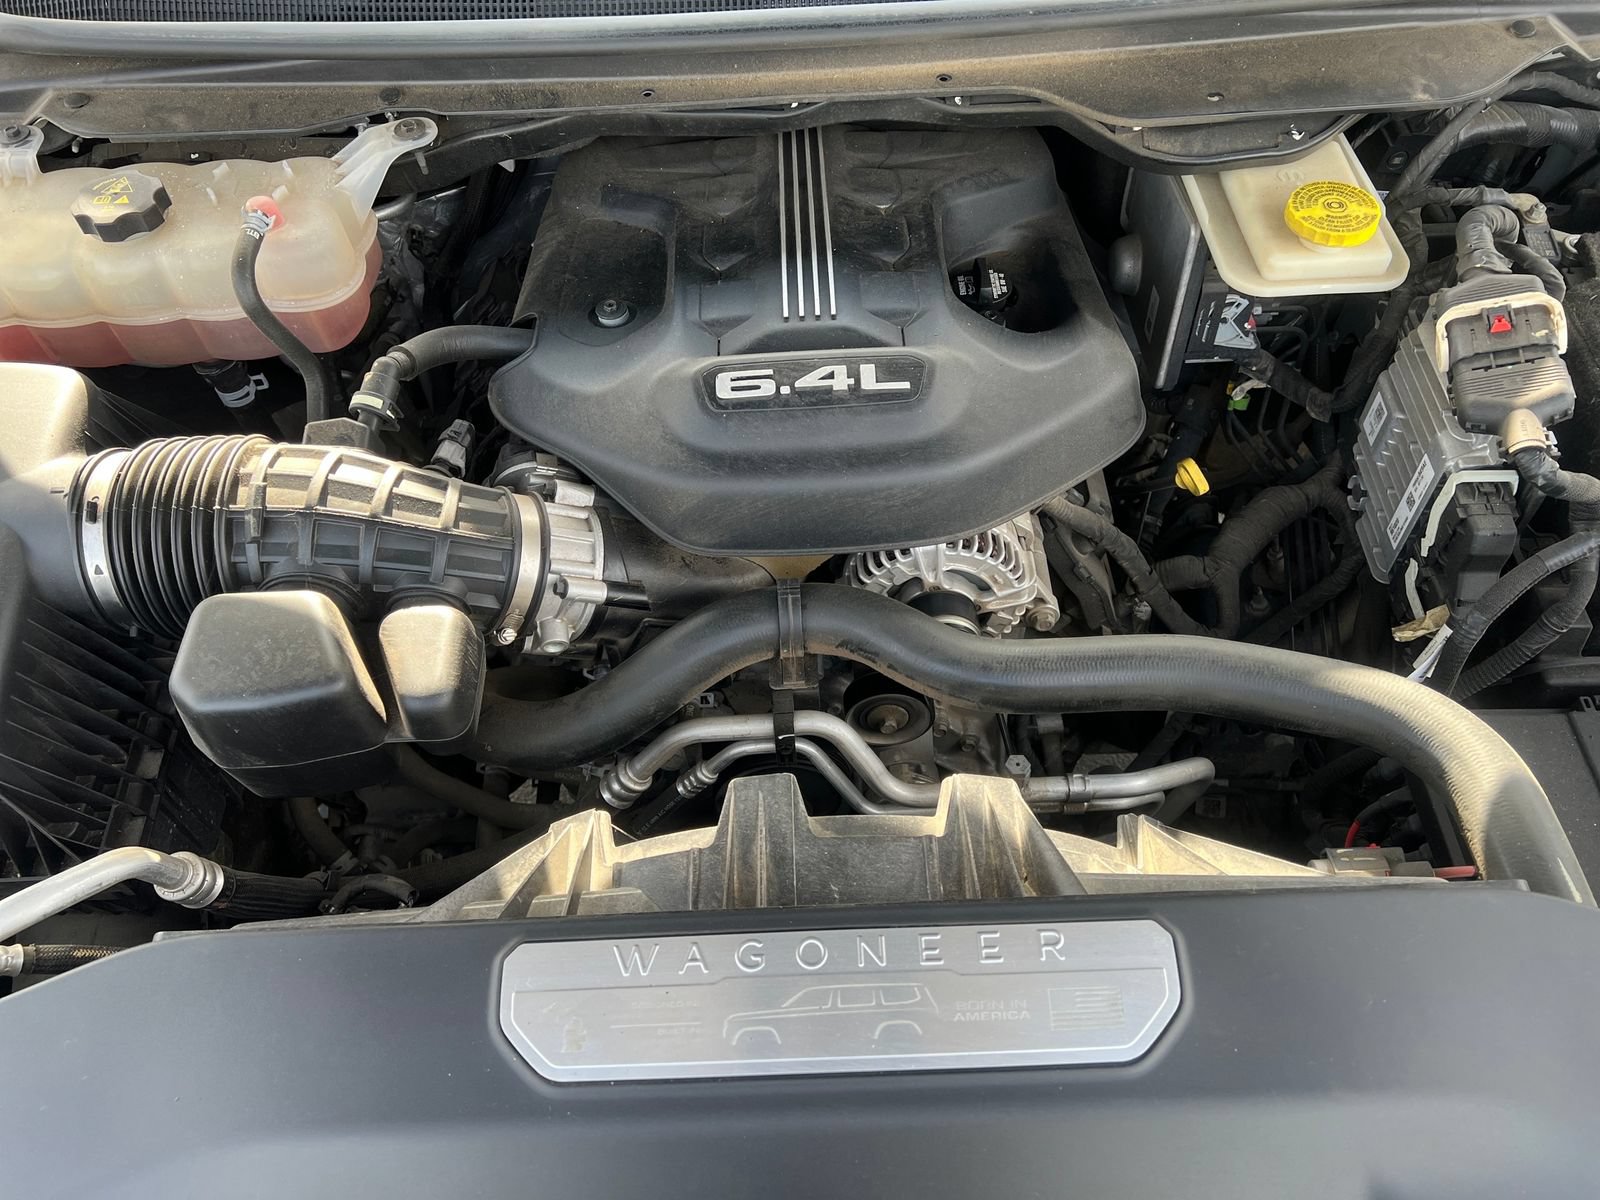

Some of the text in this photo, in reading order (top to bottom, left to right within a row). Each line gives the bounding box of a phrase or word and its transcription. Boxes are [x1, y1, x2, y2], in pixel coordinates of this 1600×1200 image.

[716, 363, 911, 399] 6.4L
[613, 929, 1066, 976] WAGONEER
[953, 1010, 1031, 1022] AMERICA
[955, 999, 1027, 1011] BORN IN
